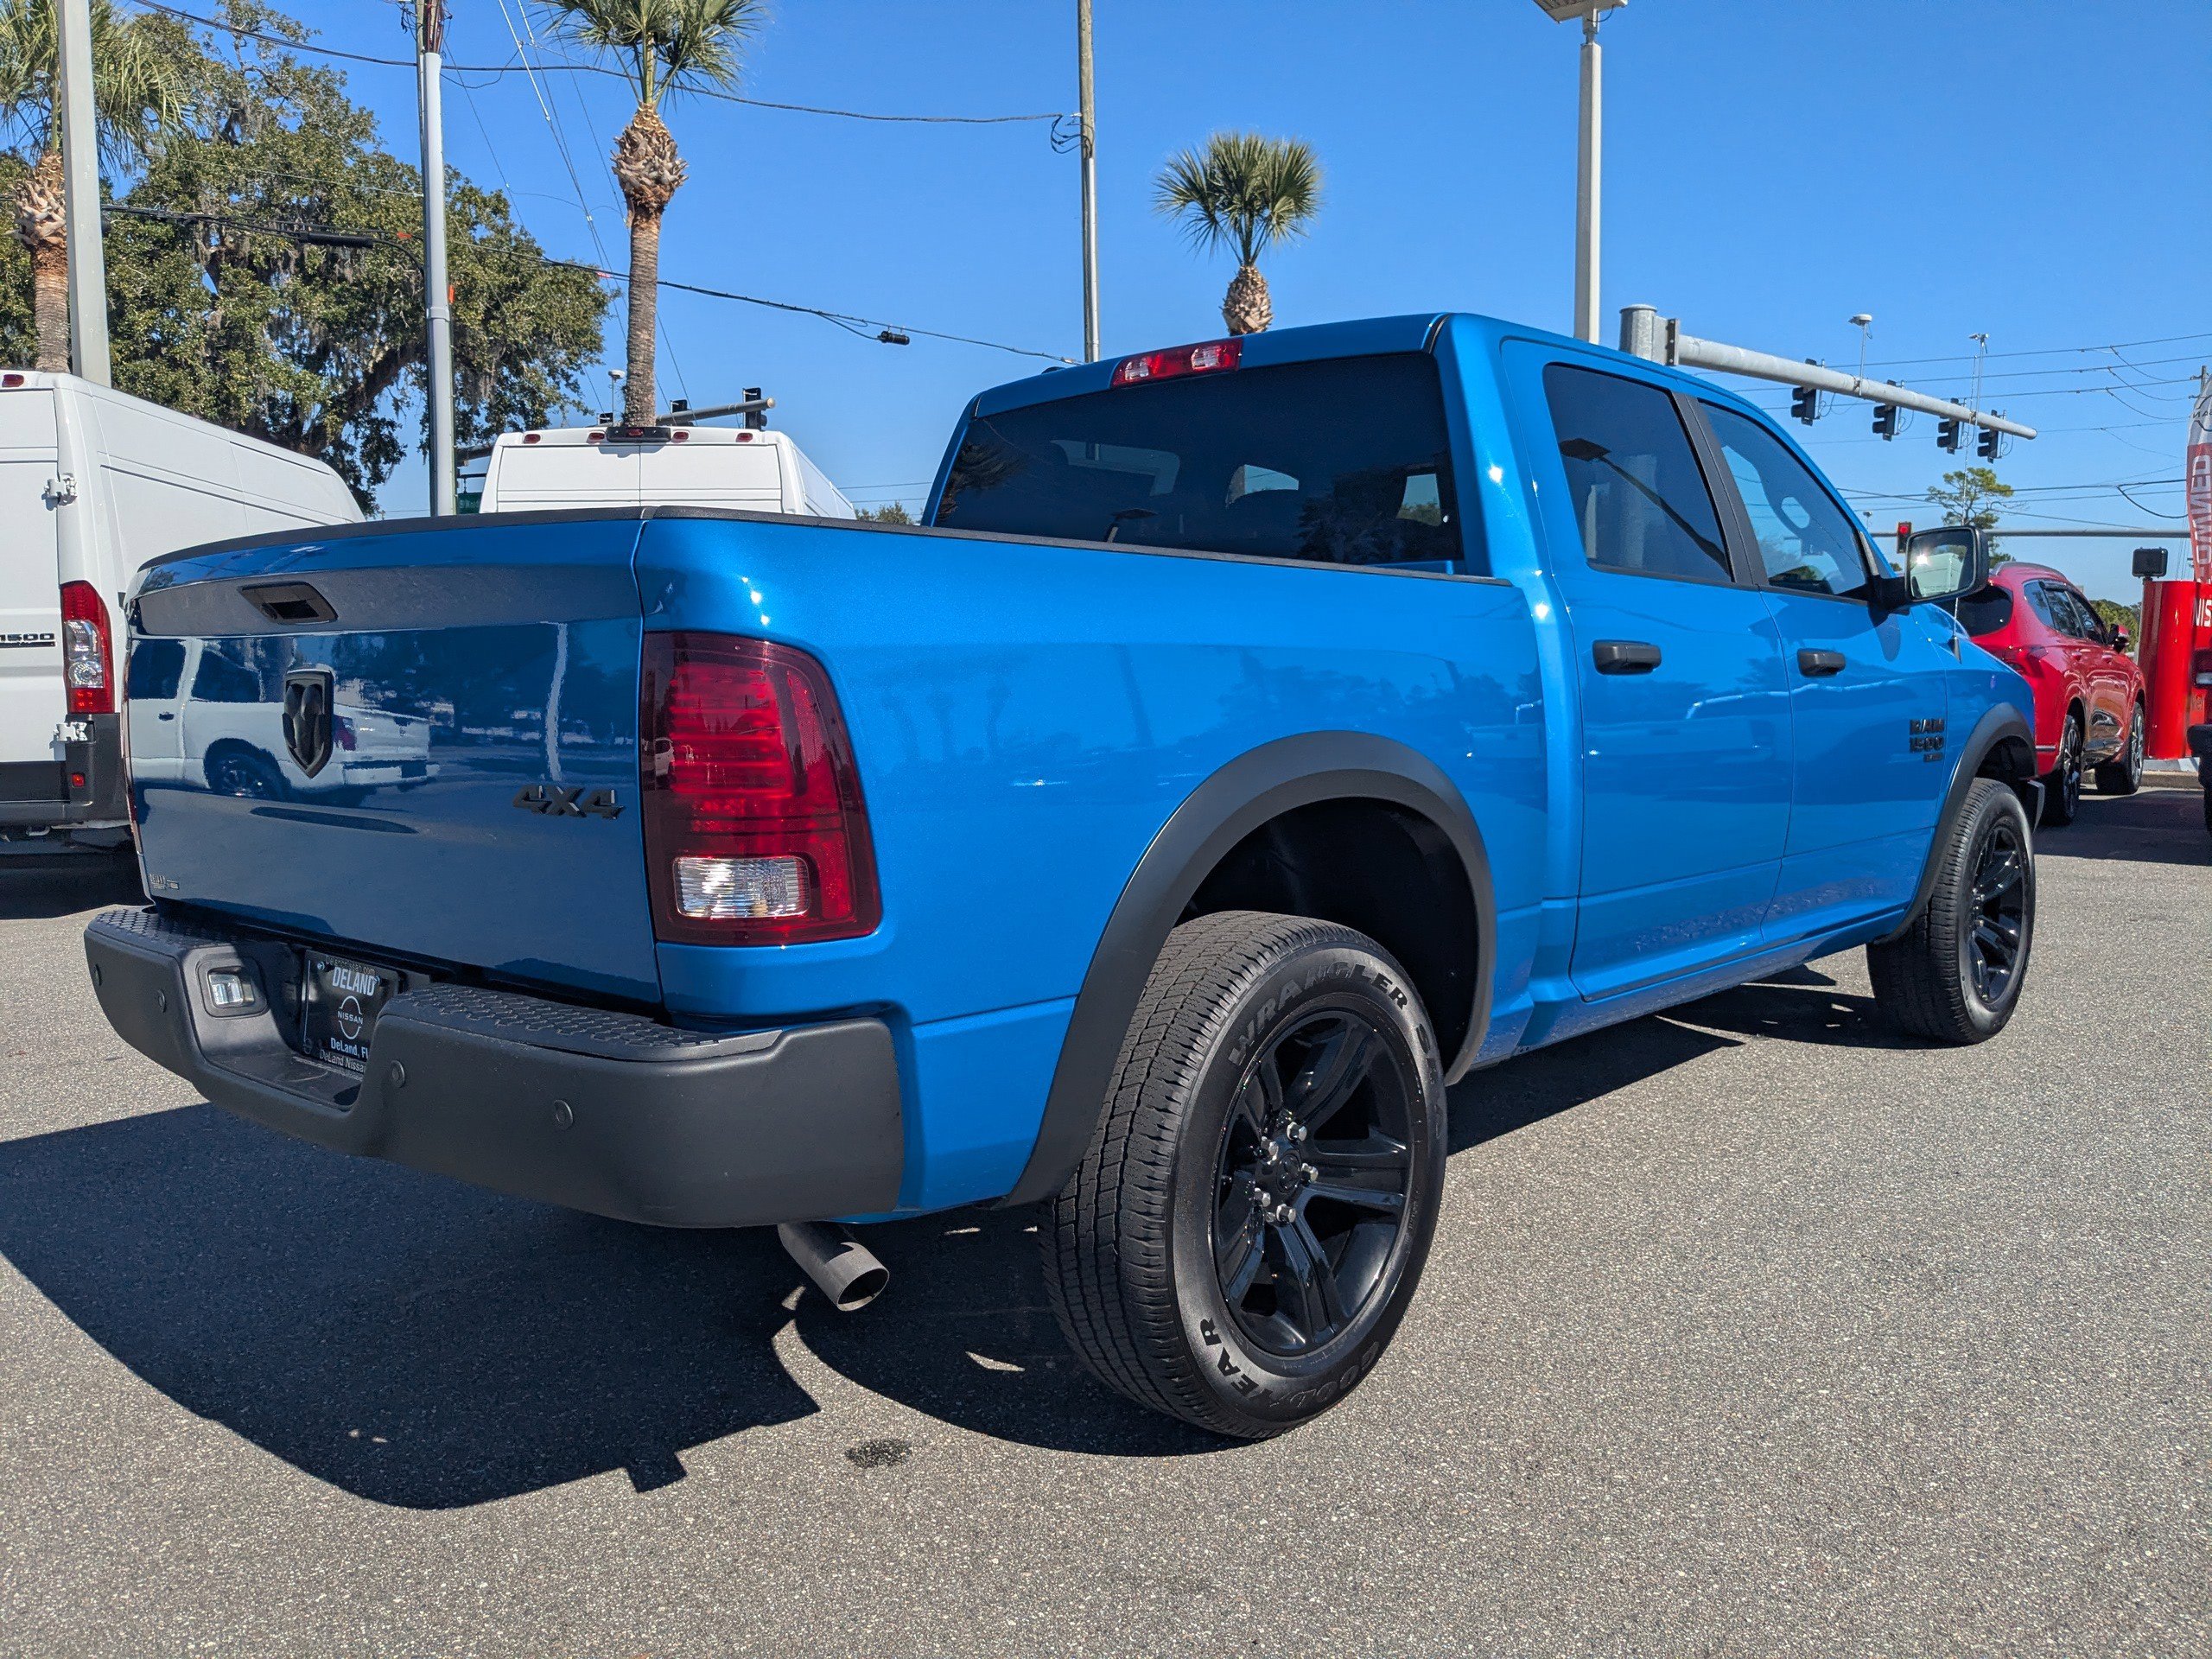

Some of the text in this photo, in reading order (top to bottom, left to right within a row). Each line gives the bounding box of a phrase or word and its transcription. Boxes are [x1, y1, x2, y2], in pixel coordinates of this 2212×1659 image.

[1909, 718, 1945, 734] RAM
[332, 966, 378, 997] DELAND
[337, 1010, 364, 1026] NISSAN
[1228, 960, 1408, 1067] WRANGLER
[330, 1037, 361, 1058] DeLand,
[319, 1048, 367, 1073] DeLand Nissa
[1199, 1316, 1380, 1408] GOODYEAR
